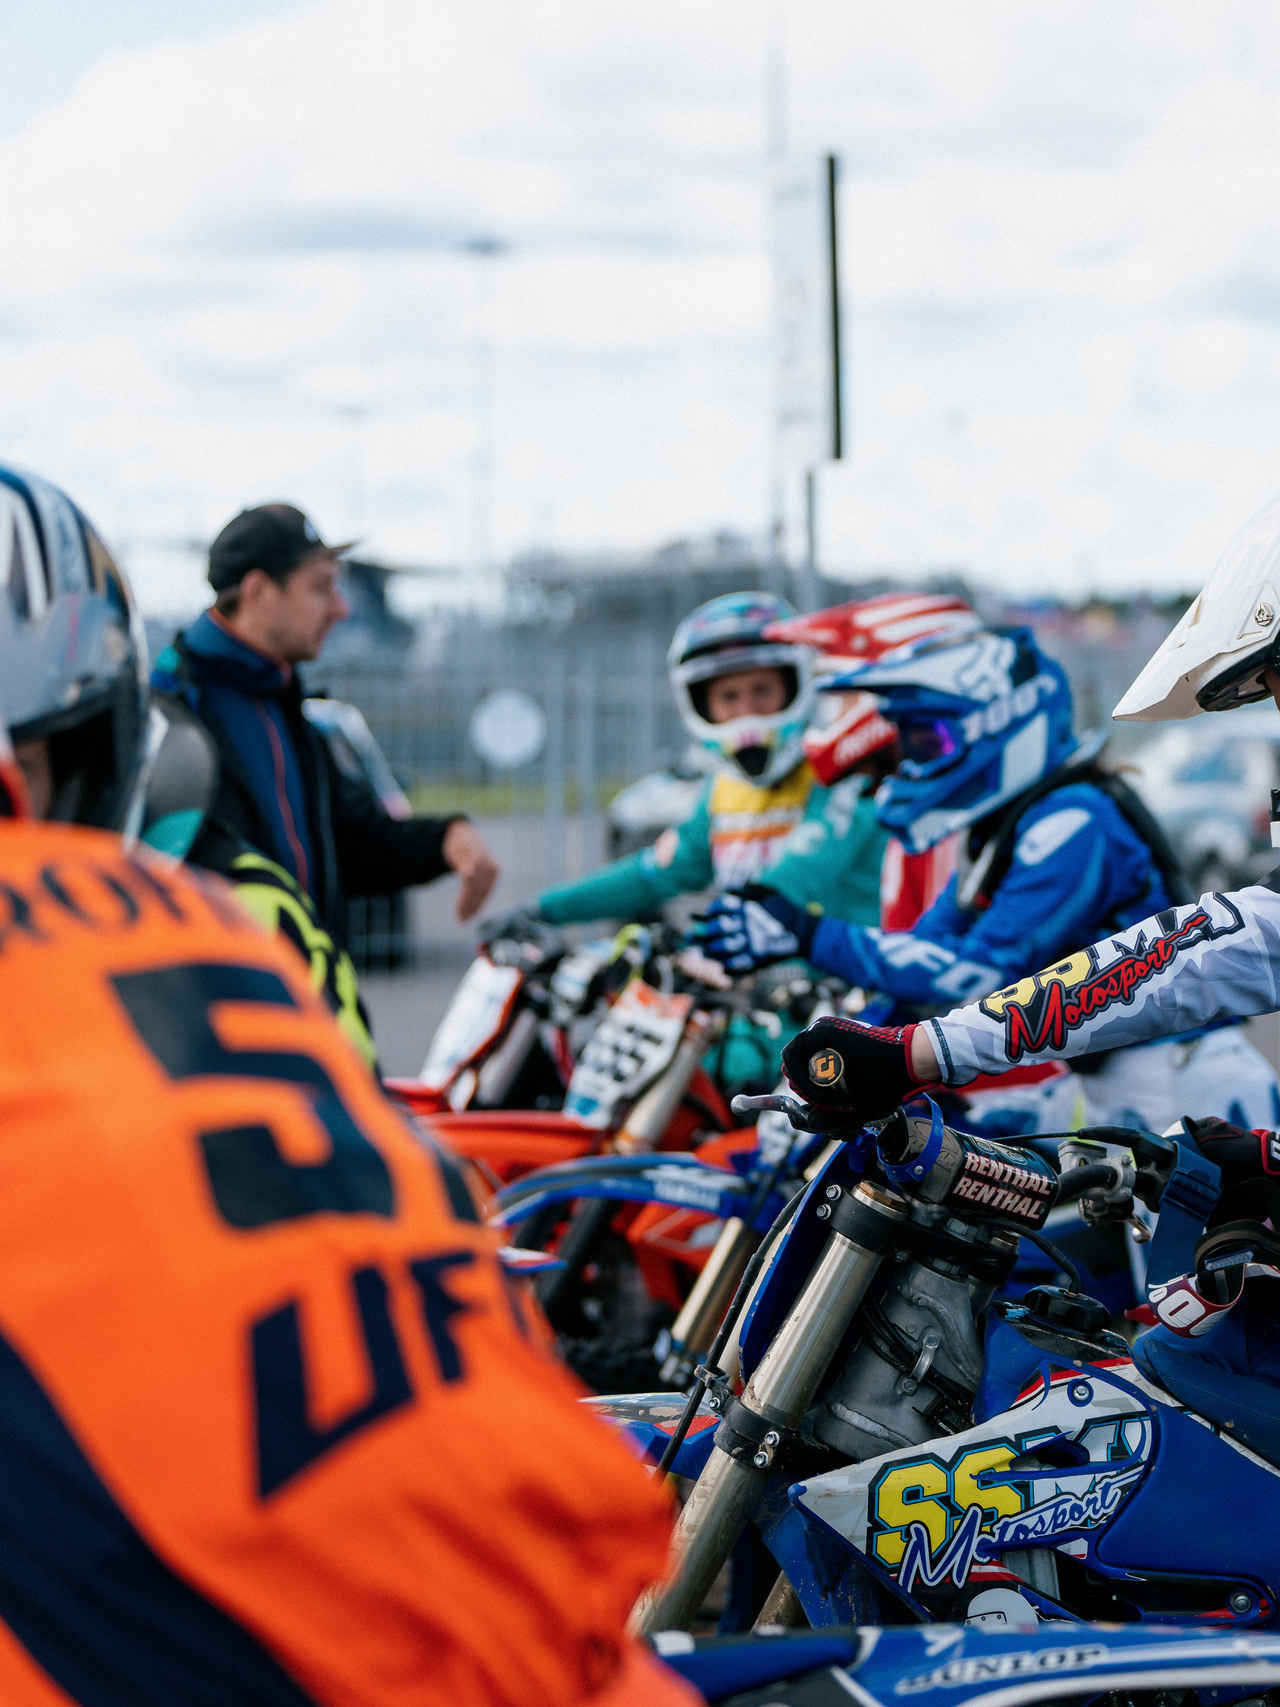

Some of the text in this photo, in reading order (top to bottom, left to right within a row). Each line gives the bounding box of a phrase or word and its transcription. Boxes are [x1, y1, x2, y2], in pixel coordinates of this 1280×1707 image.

[1006, 911, 1212, 1063] Motosport
[952, 1176, 1042, 1220] RENTHAL
[964, 1151, 1051, 1196] RENTHAL
[900, 1464, 1144, 1593] Motosport
